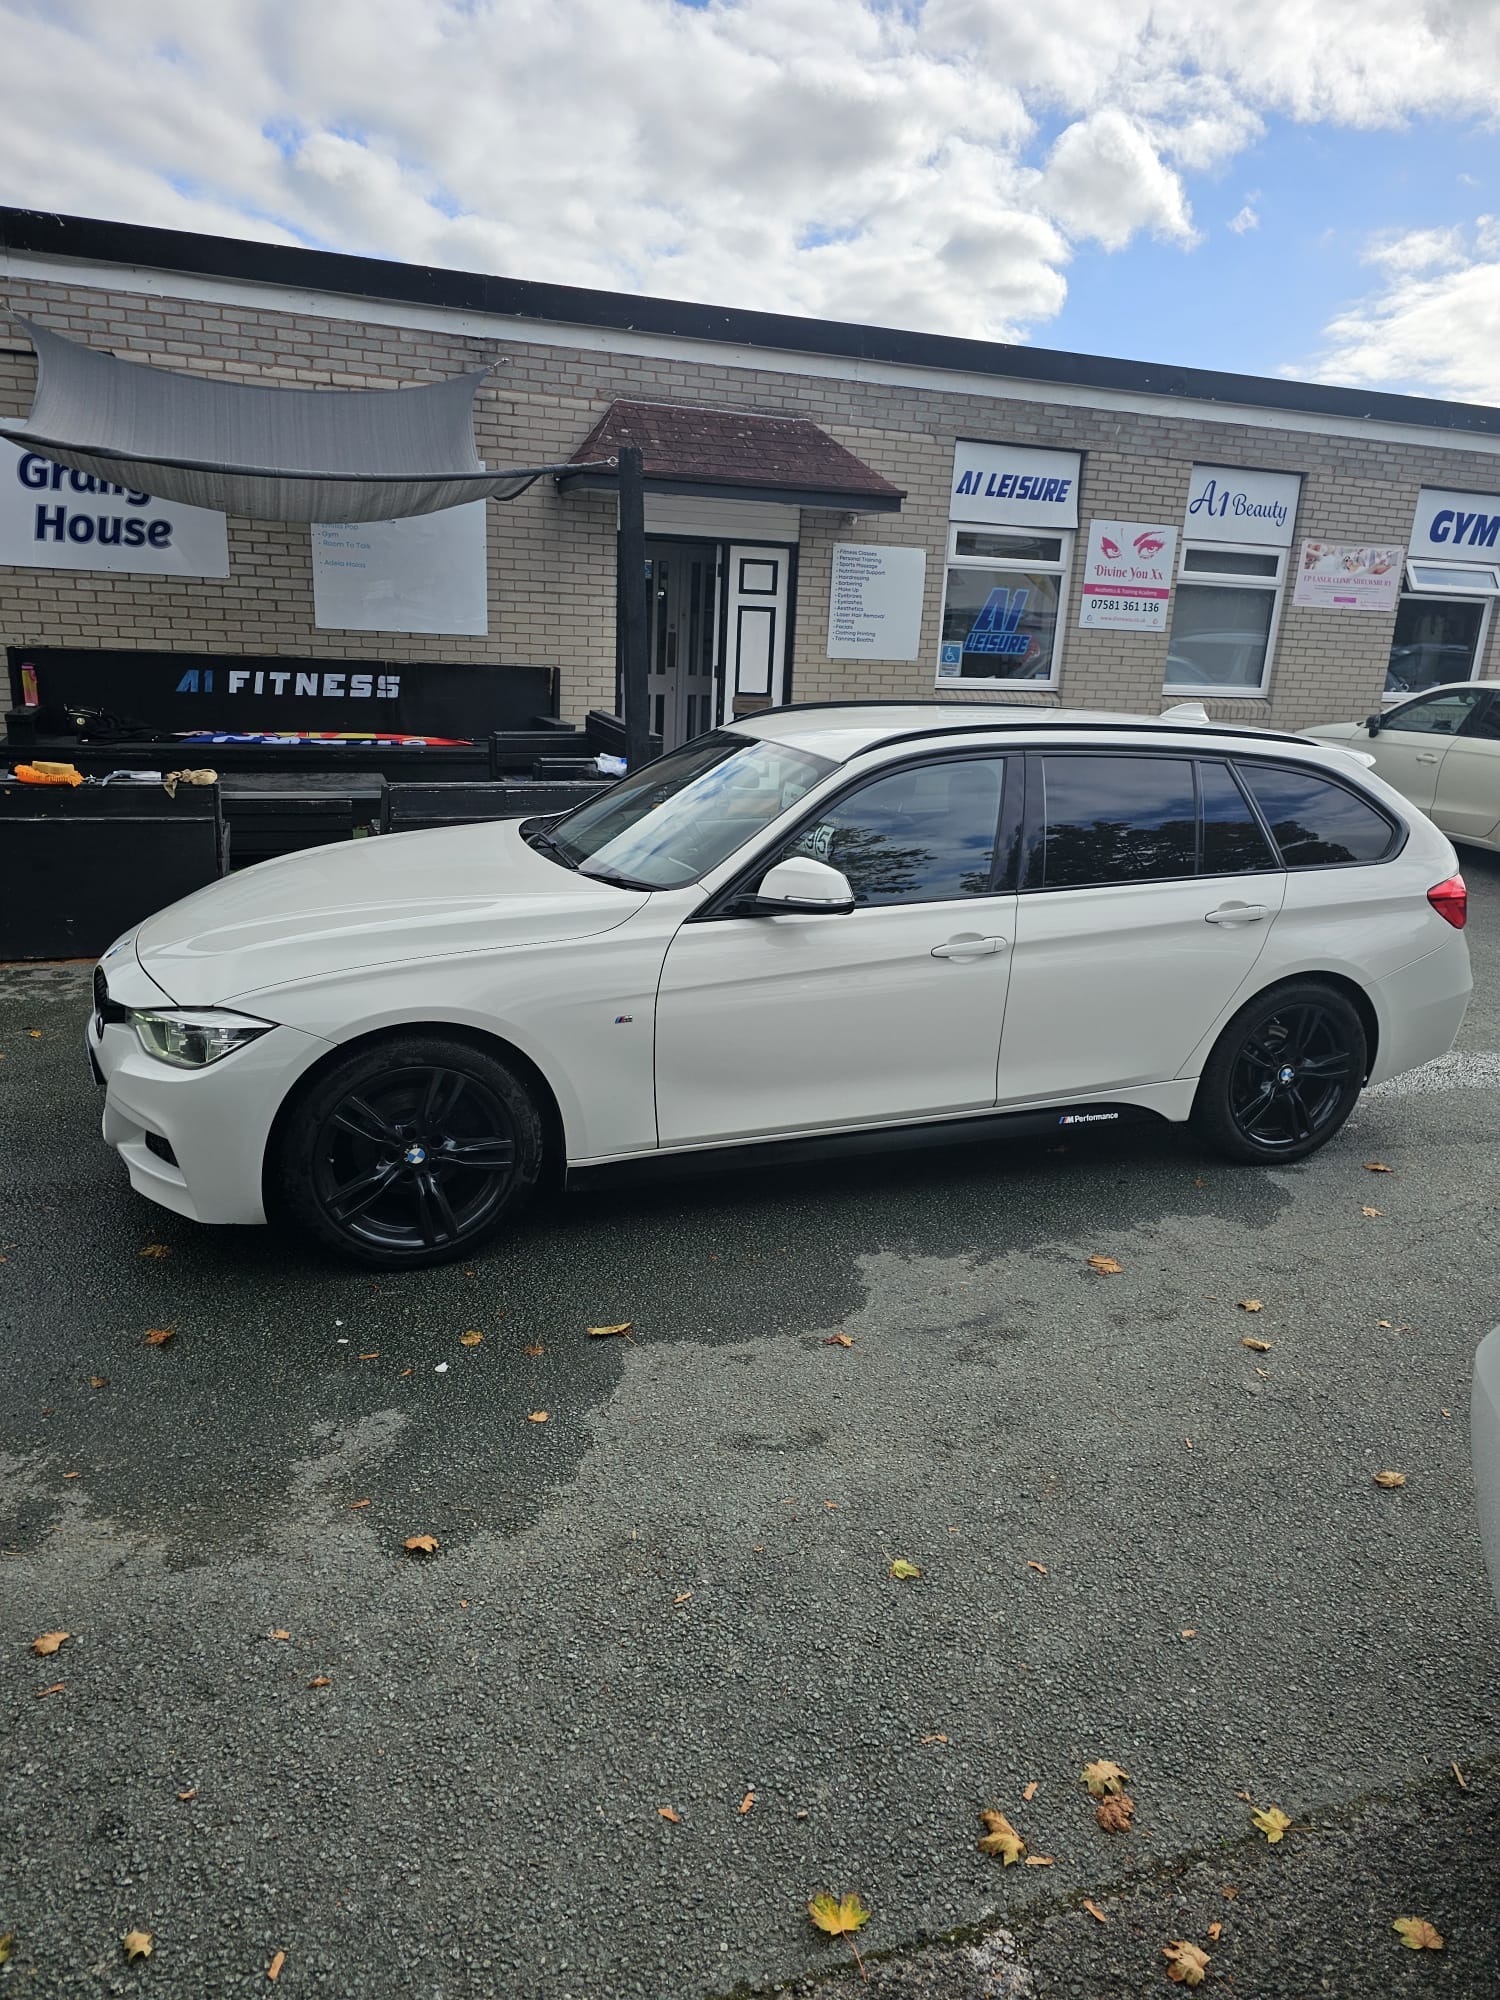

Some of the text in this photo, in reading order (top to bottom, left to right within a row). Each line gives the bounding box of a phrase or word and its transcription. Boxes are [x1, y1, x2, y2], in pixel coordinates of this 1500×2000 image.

[17, 451, 152, 507] Gra
[984, 473, 1073, 502] LEISURE
[1189, 479, 1288, 527] A1 Beauty
[34, 503, 173, 549] House
[1429, 509, 1500, 547] GYM
[856, 562, 878, 570] Massage
[862, 557, 882, 565] Training
[1094, 564, 1163, 582] Divine You Xx
[1091, 599, 1160, 613] 07581 361 136
[963, 632, 1032, 654] LEISURE
[176, 669, 400, 698] A1 FITNESS
[1075, 1112, 1119, 1123] Performance
